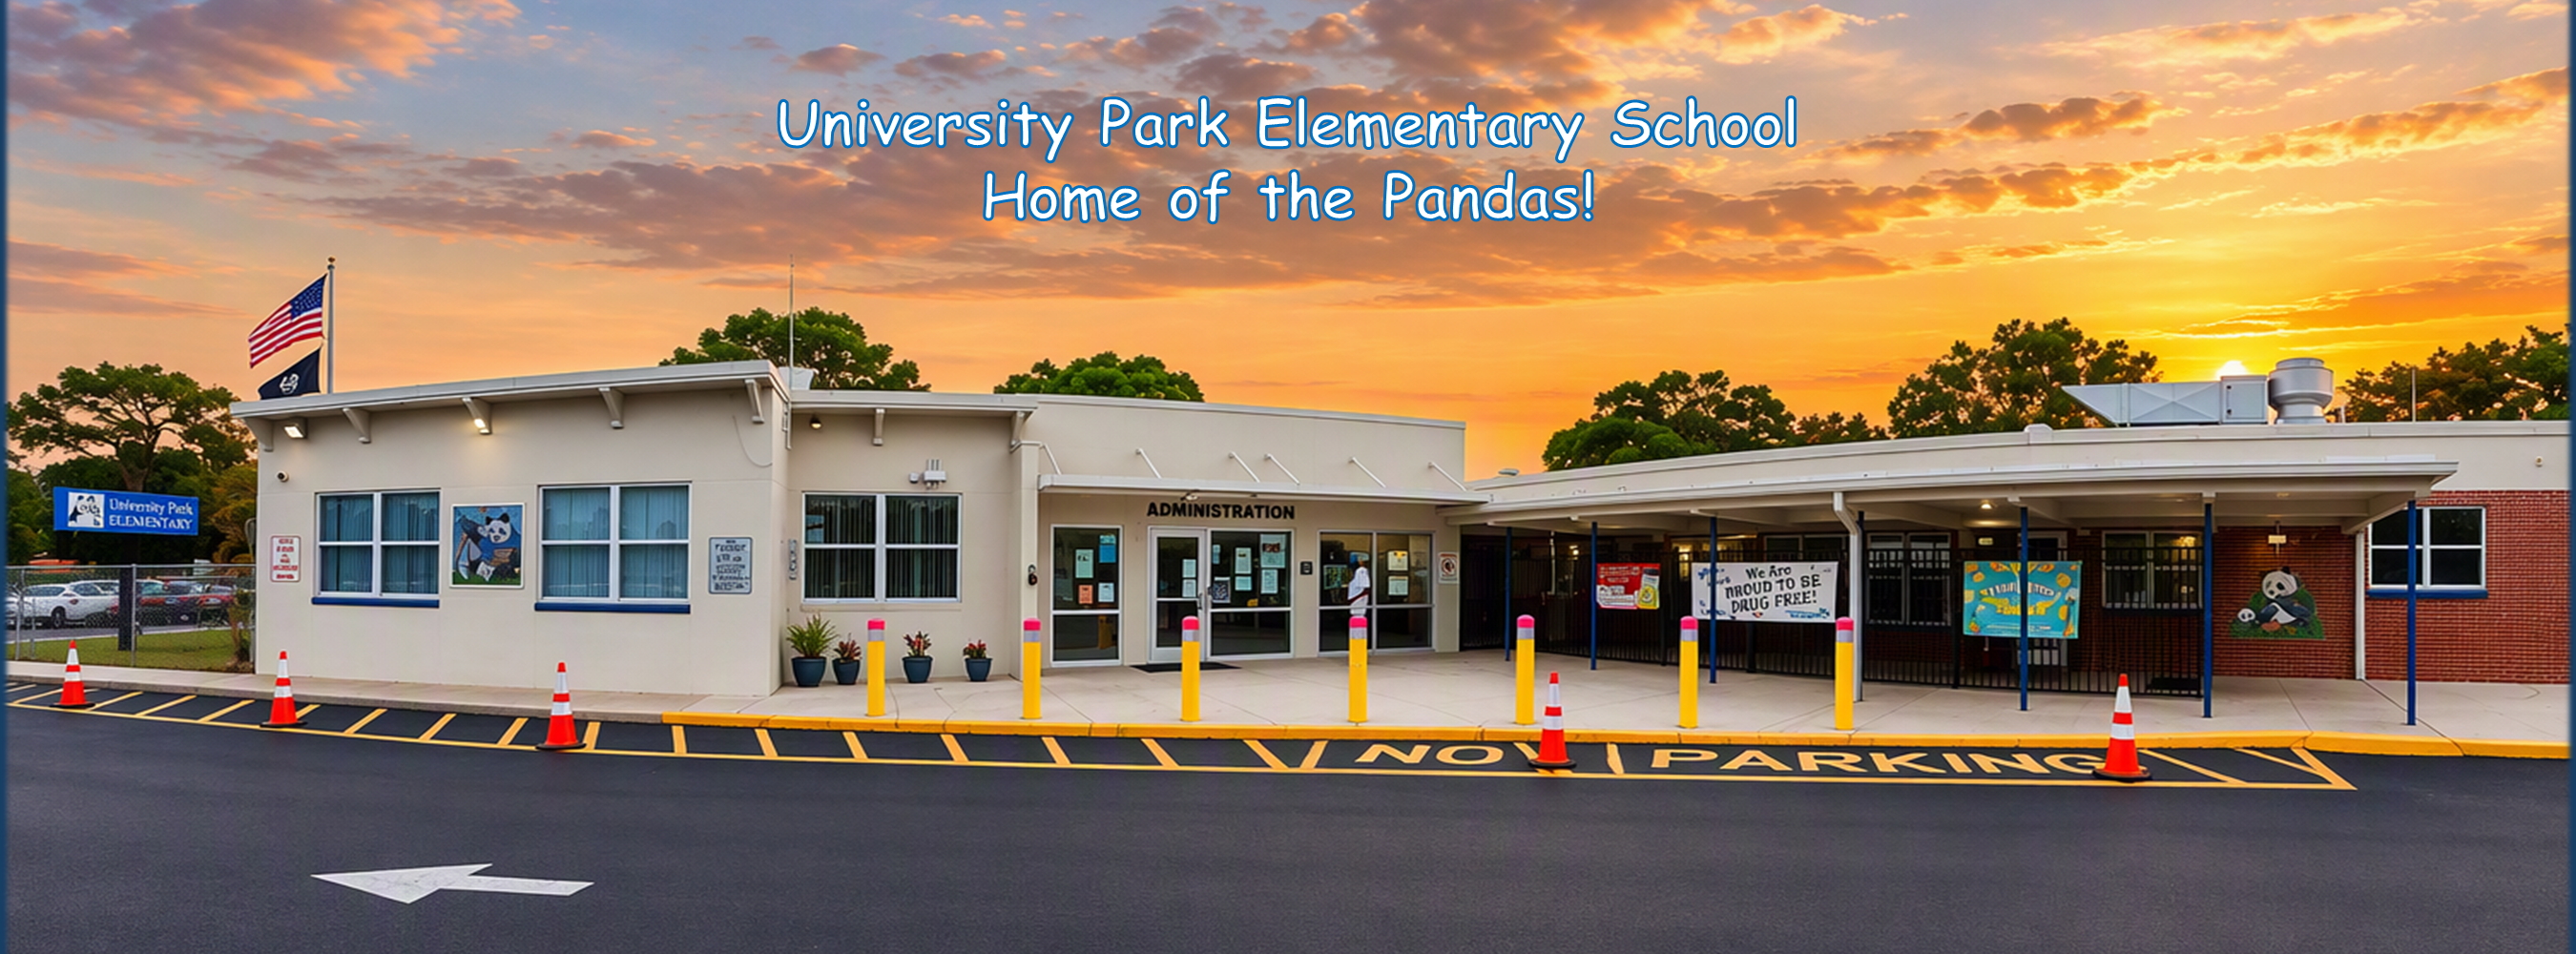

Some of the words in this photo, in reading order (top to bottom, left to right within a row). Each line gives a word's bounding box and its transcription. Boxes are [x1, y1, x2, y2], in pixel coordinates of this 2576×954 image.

[1147, 502, 1295, 520] ADMINISTRATION
[1745, 567, 1765, 579] We
[1776, 577, 1796, 591] TO
[1732, 596, 1769, 613] DRUG
[1355, 744, 1504, 764] NO
[1651, 748, 2106, 774] PARKING
